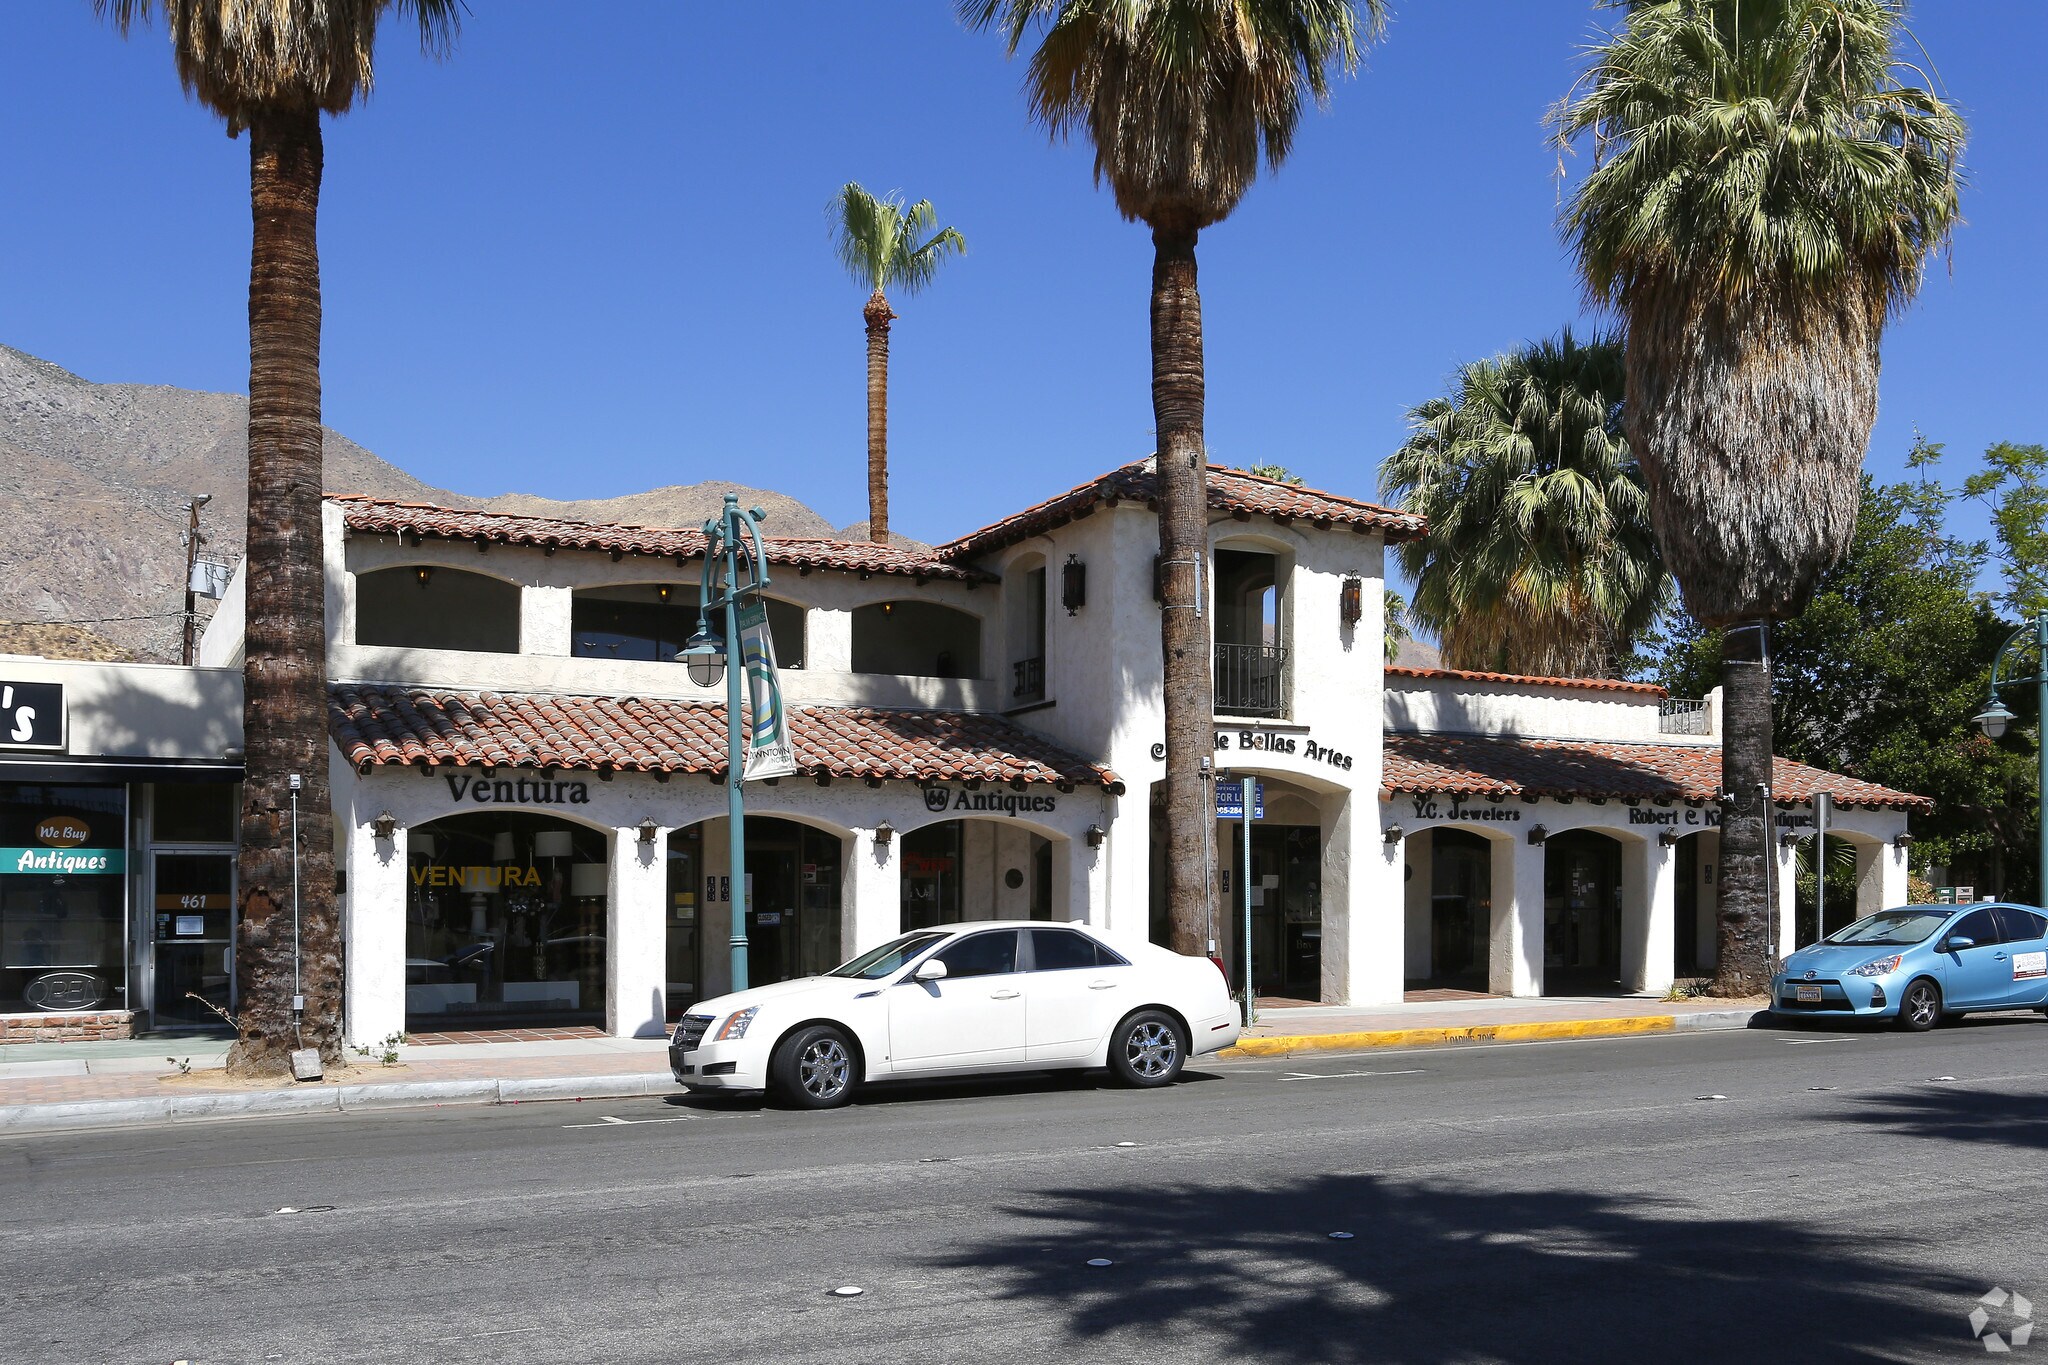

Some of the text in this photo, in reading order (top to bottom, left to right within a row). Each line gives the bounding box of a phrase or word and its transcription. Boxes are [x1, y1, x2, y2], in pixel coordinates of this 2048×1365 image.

[749, 746, 792, 760] DOWNTOWN
[1239, 730, 1296, 755] Bellas
[1304, 739, 1354, 772] Artes
[444, 774, 591, 804] Ventura
[1216, 793, 1232, 802] FOR
[928, 789, 1056, 818] 66 Antiques
[1447, 800, 1521, 821] Jewelers
[1629, 807, 1679, 825] Robert
[1774, 811, 1813, 828] tiques
[40, 826, 87, 842] We Buy
[17, 849, 107, 874] Antiques
[410, 866, 542, 887] VENTURA
[181, 895, 206, 909] 461
[27, 981, 104, 1004] OPEN
